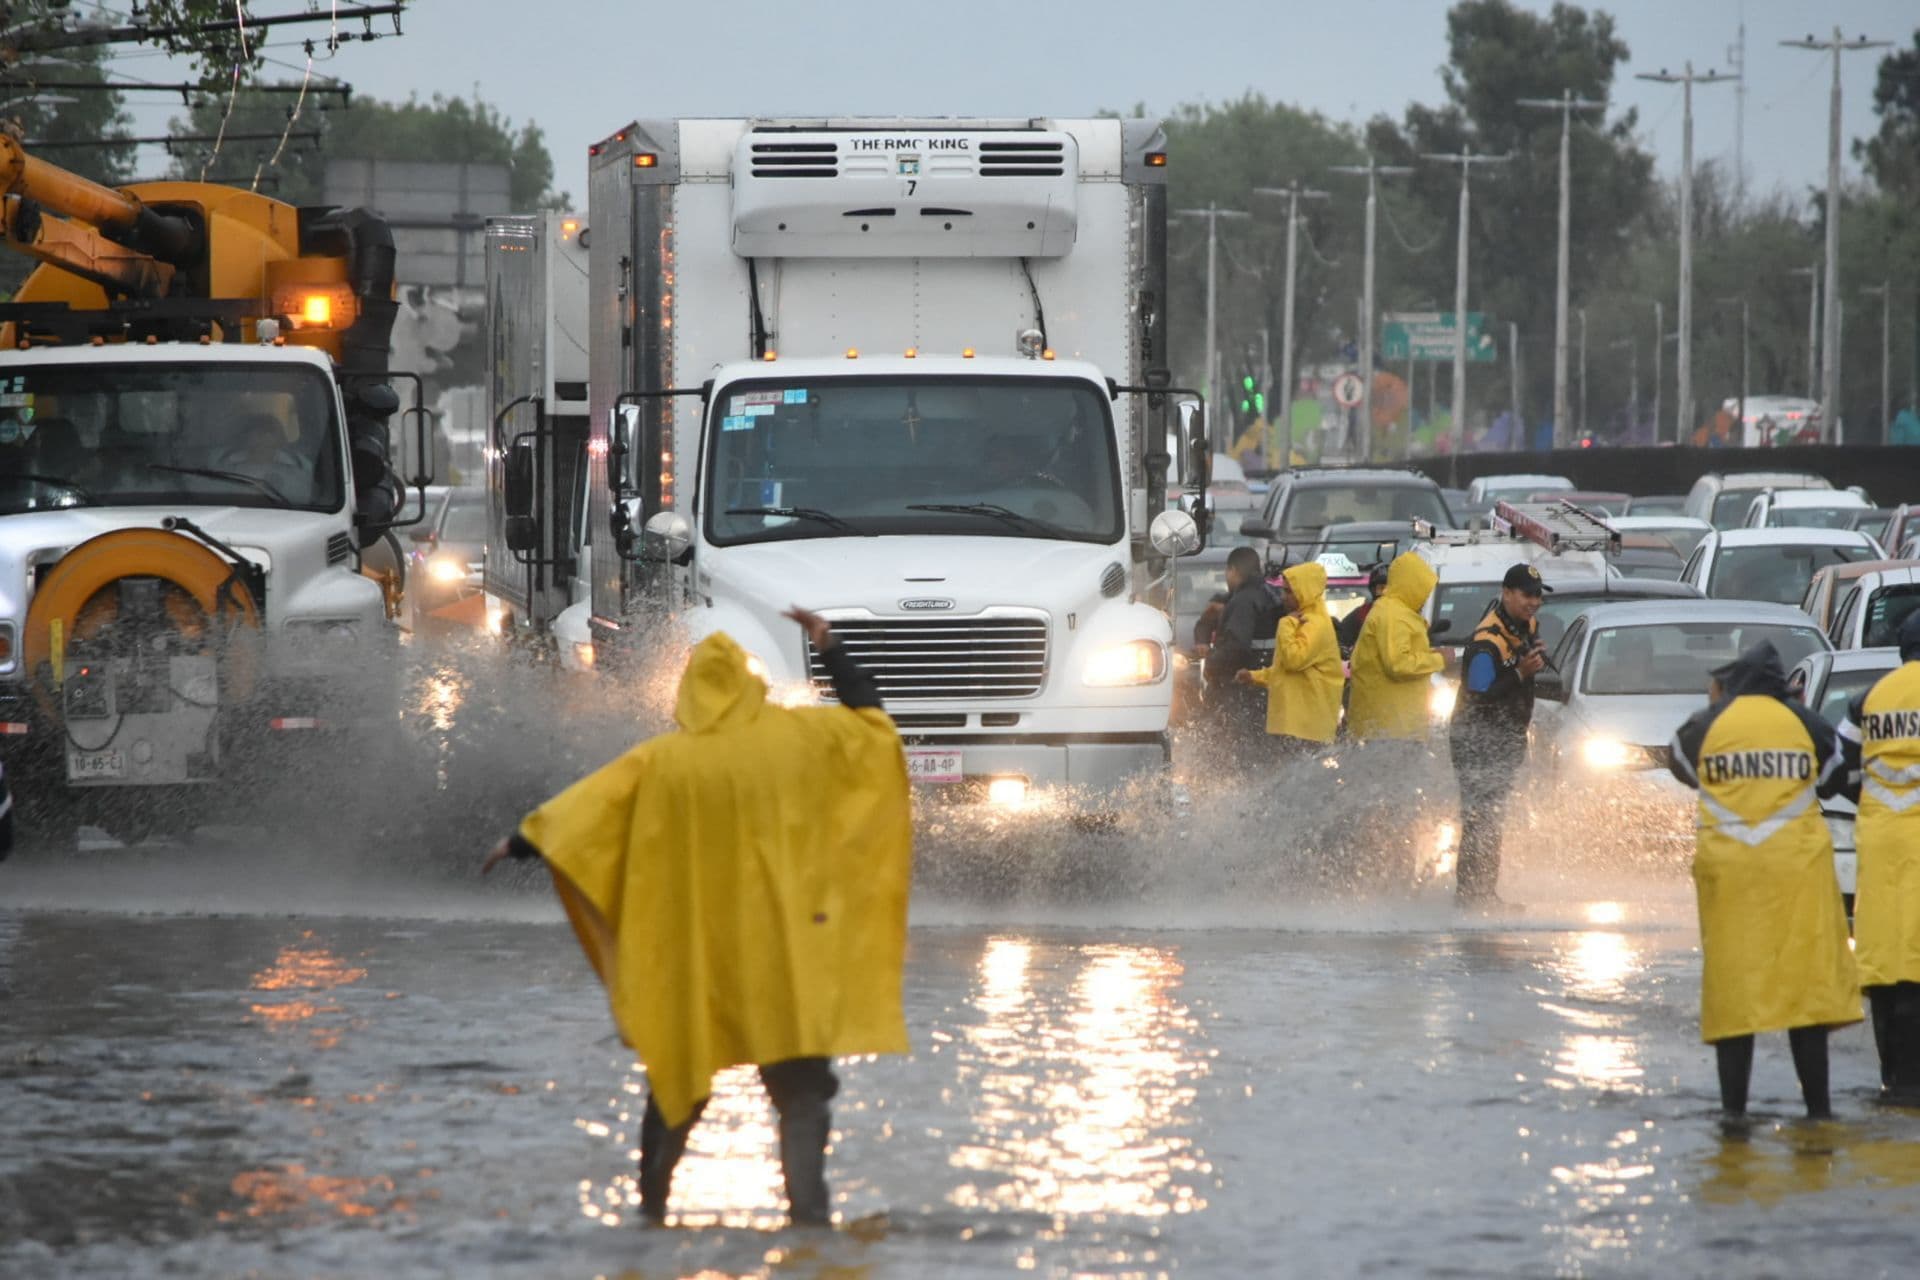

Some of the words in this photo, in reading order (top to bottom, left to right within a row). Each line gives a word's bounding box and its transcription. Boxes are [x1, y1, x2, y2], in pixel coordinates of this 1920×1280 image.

[928, 138, 969, 150] KING
[1319, 556, 1344, 568] TAXI
[1704, 751, 1811, 785] TRANSITO
